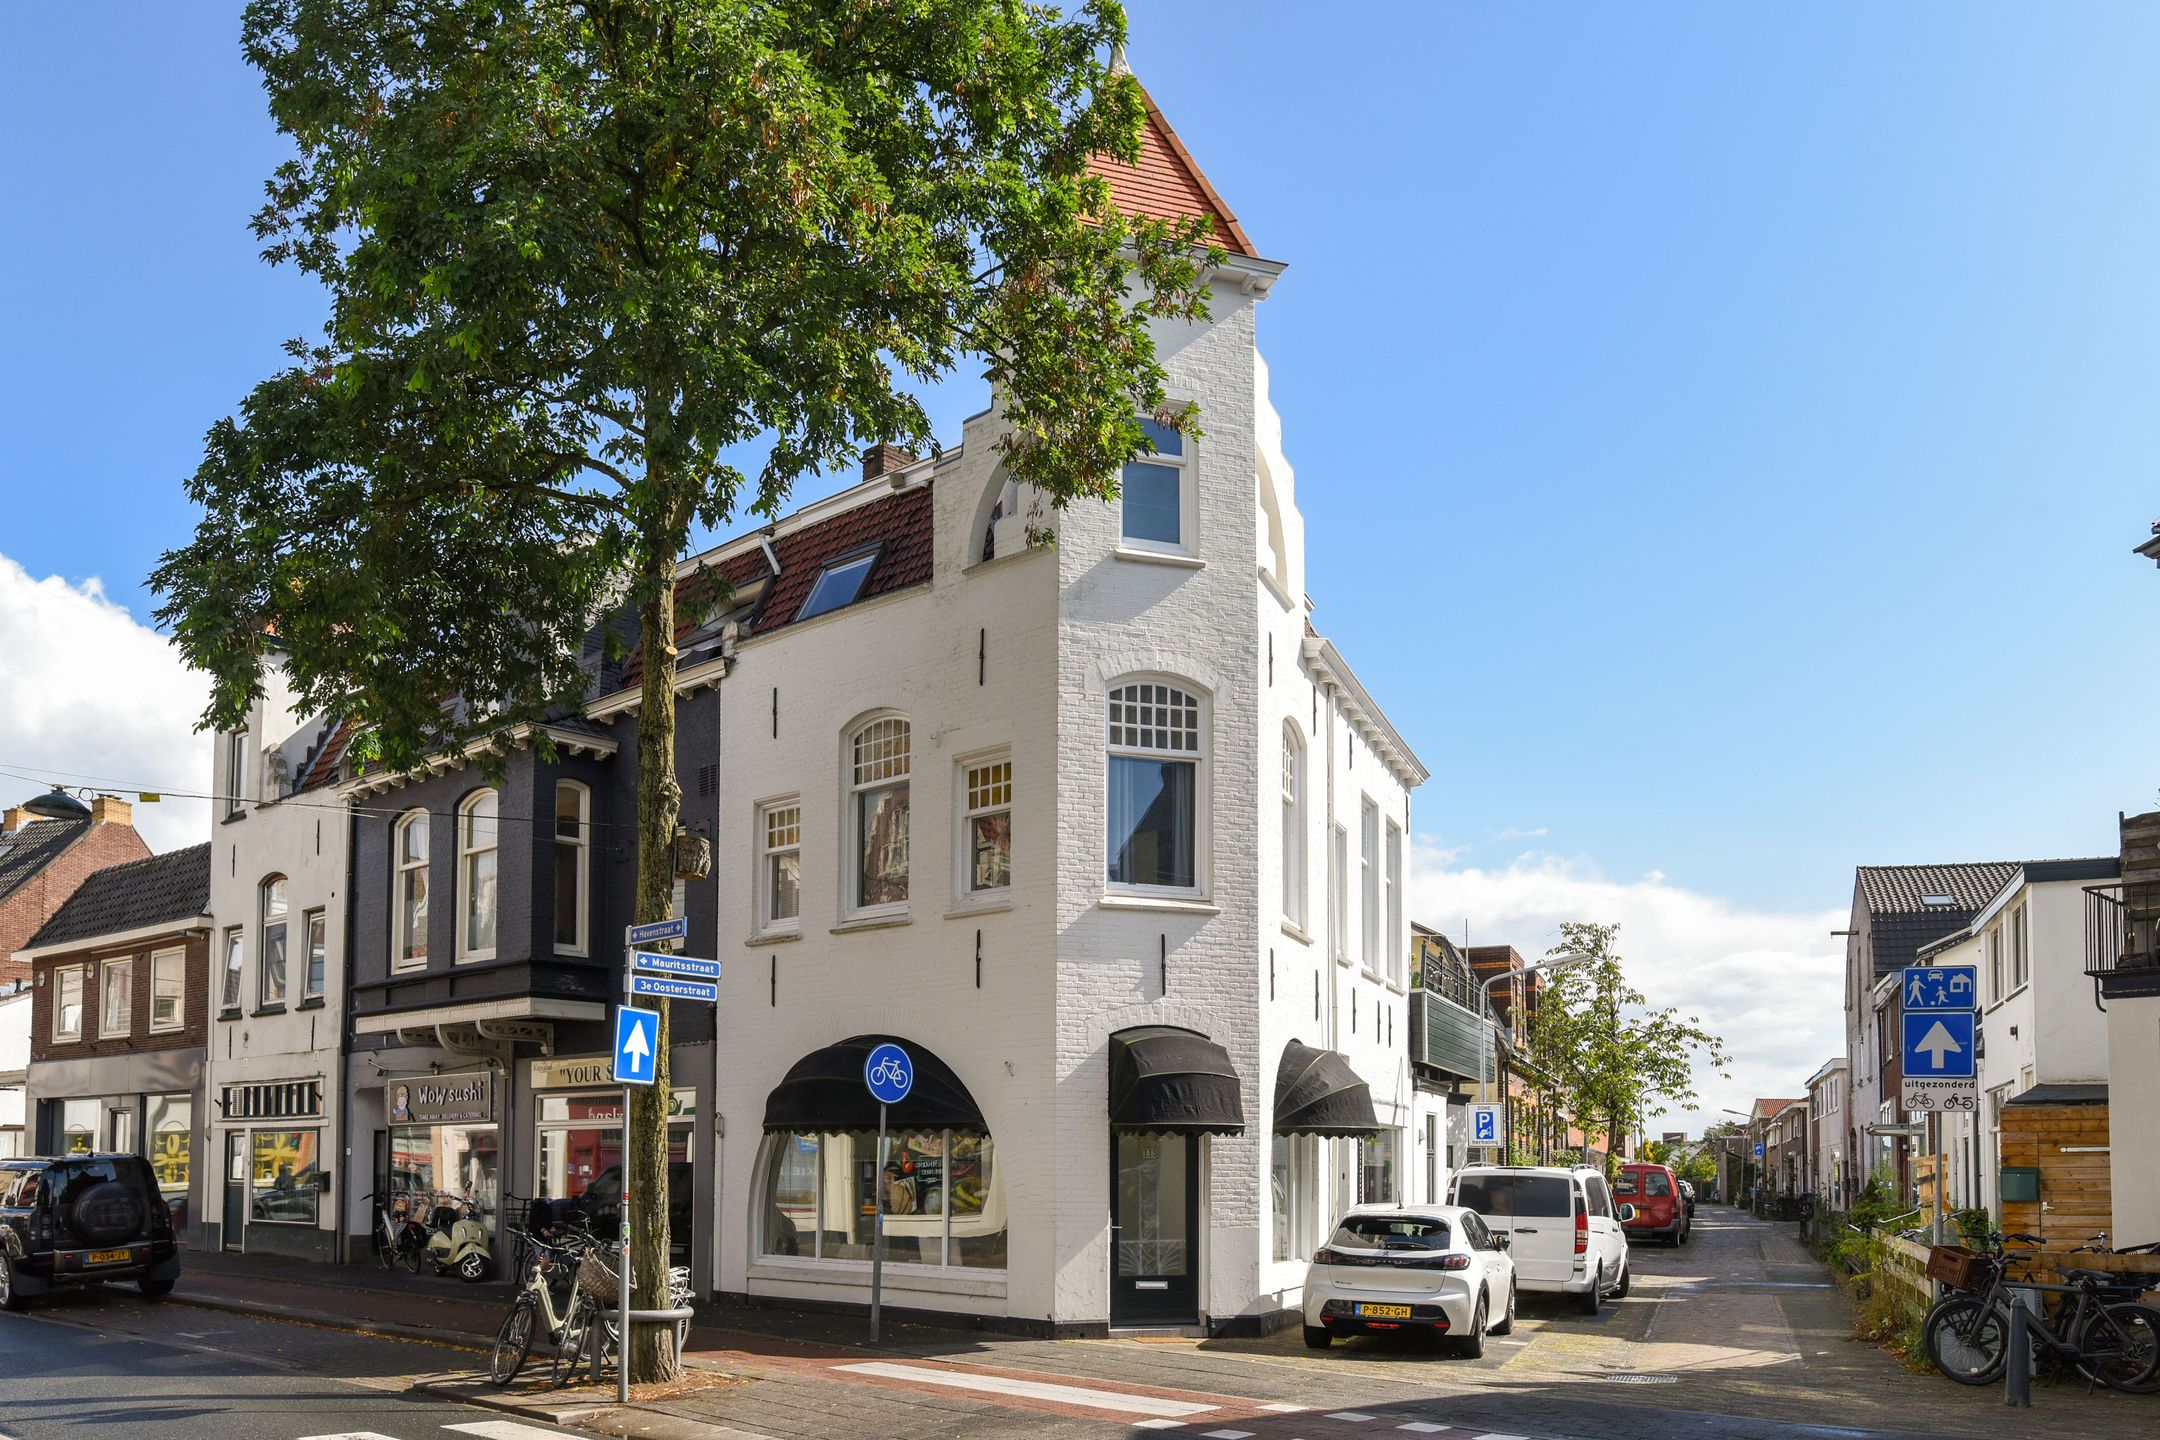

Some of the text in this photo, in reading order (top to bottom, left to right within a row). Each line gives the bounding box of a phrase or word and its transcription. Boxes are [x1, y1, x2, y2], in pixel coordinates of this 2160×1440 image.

[639, 925, 674, 938] Havenstraat
[652, 958, 714, 973] Mauritsstraat
[640, 981, 711, 996] 3e Oosterstraat
[559, 1065, 601, 1084] "YOUR
[448, 1081, 483, 1102] sushi
[1904, 1080, 1975, 1089] uitgezonderd
[1363, 1305, 1408, 1316] P-852-GH
